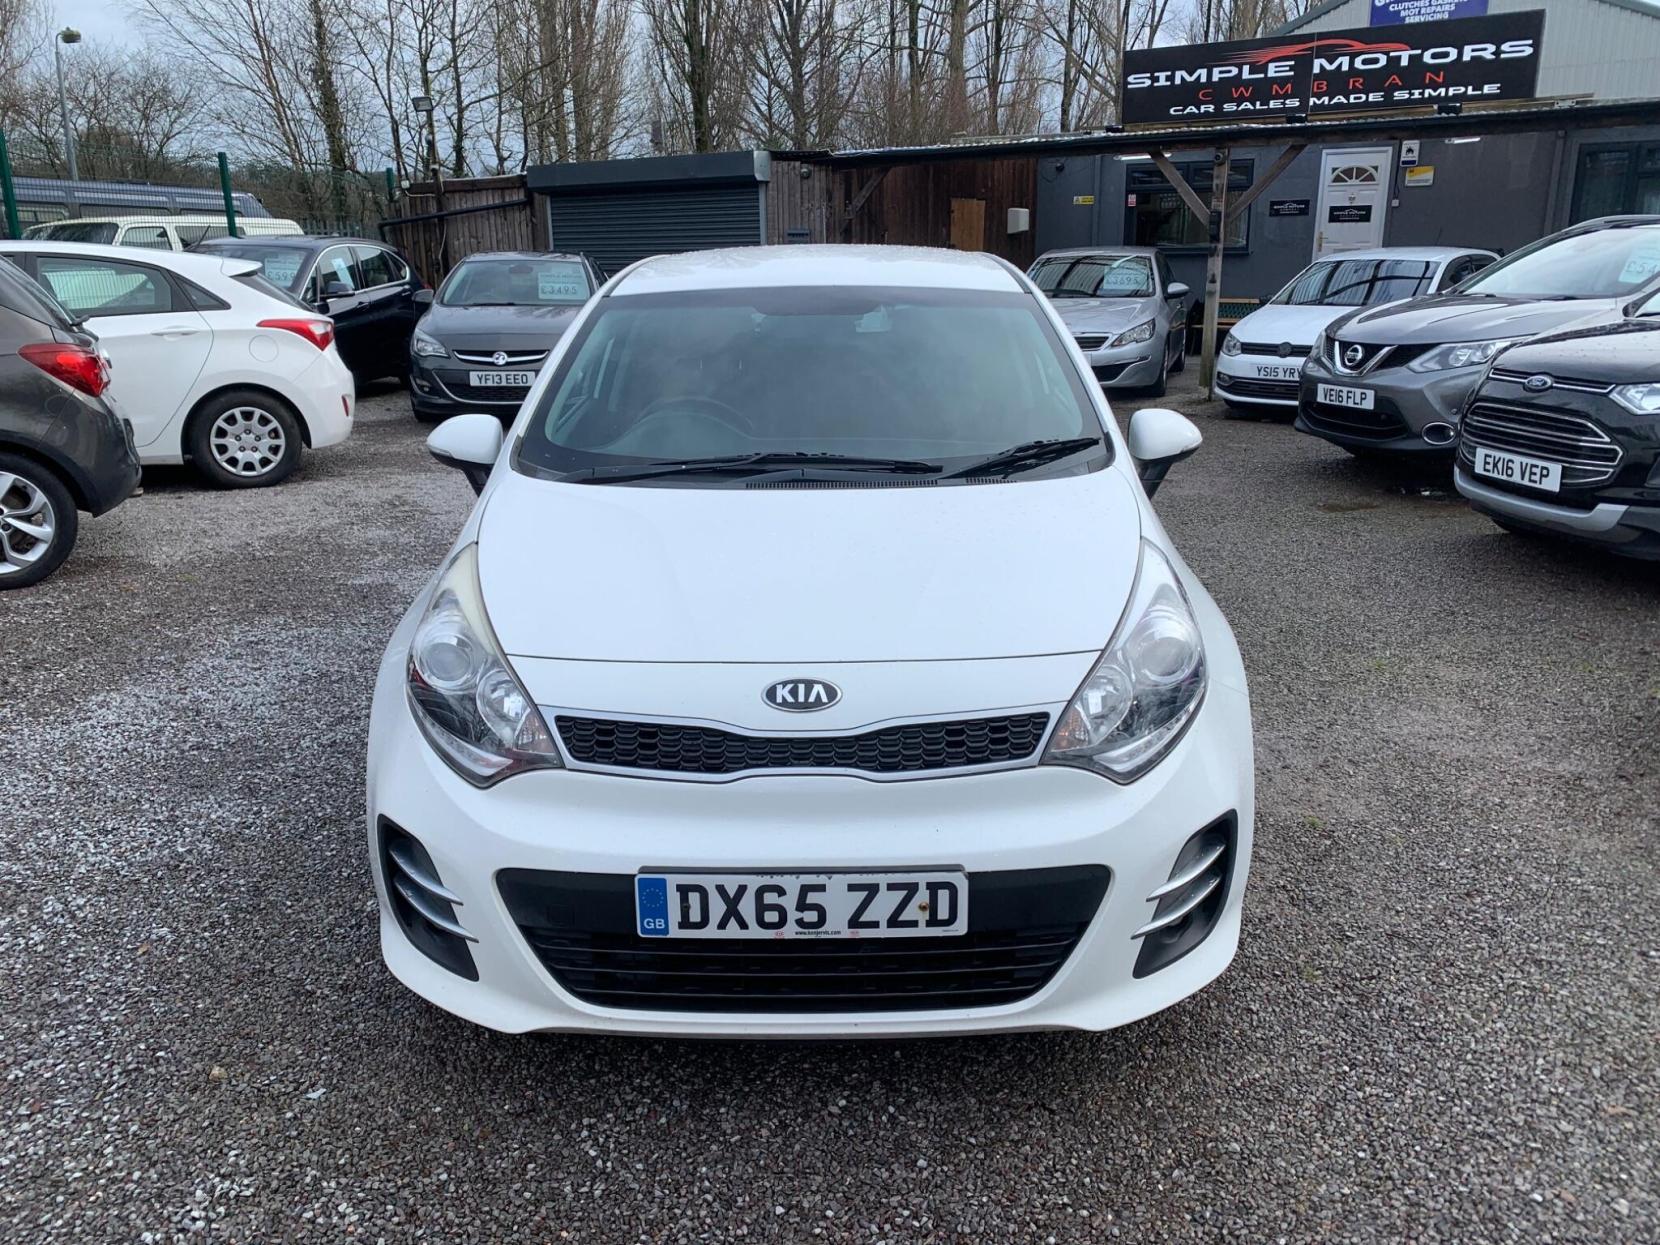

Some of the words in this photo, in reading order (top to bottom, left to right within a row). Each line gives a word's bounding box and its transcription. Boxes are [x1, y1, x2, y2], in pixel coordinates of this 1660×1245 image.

[1389, 0, 1429, 11] CLUTCHES
[1400, 8, 1420, 17] MOT
[1421, 4, 1455, 15] REPAIRS
[1404, 12, 1449, 24] SERVICING
[1127, 60, 1295, 89] SIMPLE
[1313, 39, 1534, 73] MOTORS
[1199, 71, 1444, 100] CWMBRAN
[1169, 104, 1215, 115] CAR
[1223, 98, 1300, 112] SALES
[1309, 92, 1385, 106] MADE
[1393, 83, 1501, 100] SIMPLE
[477, 374, 503, 384] YF13
[505, 374, 528, 384] EEO
[1256, 366, 1279, 377] YS15
[1323, 387, 1344, 403] VE16
[1346, 390, 1367, 406] FLP
[1483, 453, 1514, 478] EK16
[1520, 461, 1550, 485] VEP
[776, 683, 828, 703] KIA
[675, 883, 827, 930] DX65
[847, 881, 958, 929] ZZD
[643, 918, 665, 929] GB
